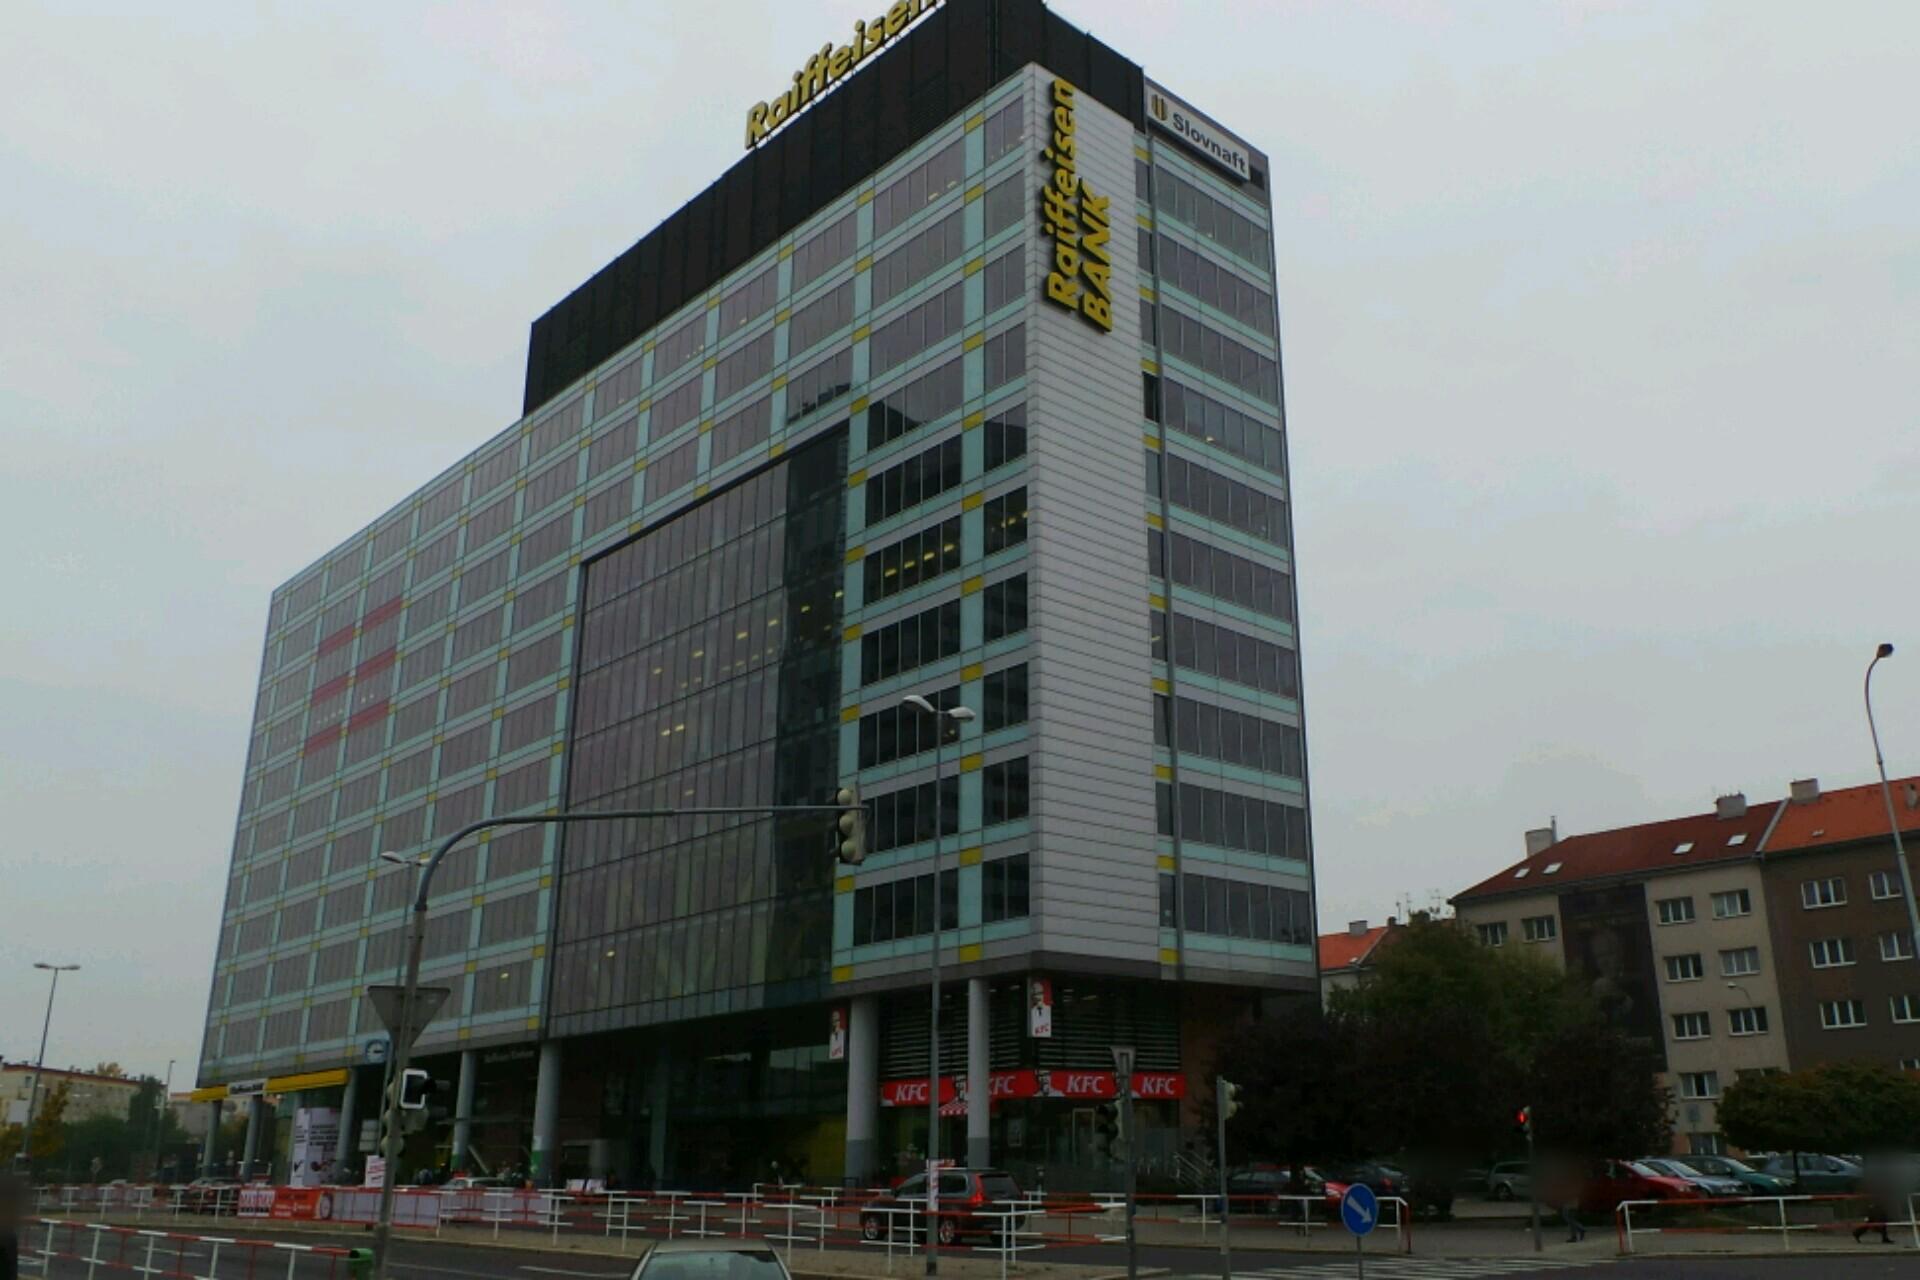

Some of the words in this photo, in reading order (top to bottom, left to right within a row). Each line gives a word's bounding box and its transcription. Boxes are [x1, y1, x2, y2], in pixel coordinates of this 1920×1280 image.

[1173, 112, 1246, 173] Slovnaft
[1043, 78, 1077, 311] Raiffeisen
[1081, 179, 1113, 333] BANK
[895, 1083, 928, 1102] KFC
[1066, 1075, 1104, 1094] KFC
[1141, 1077, 1177, 1096] KFC
